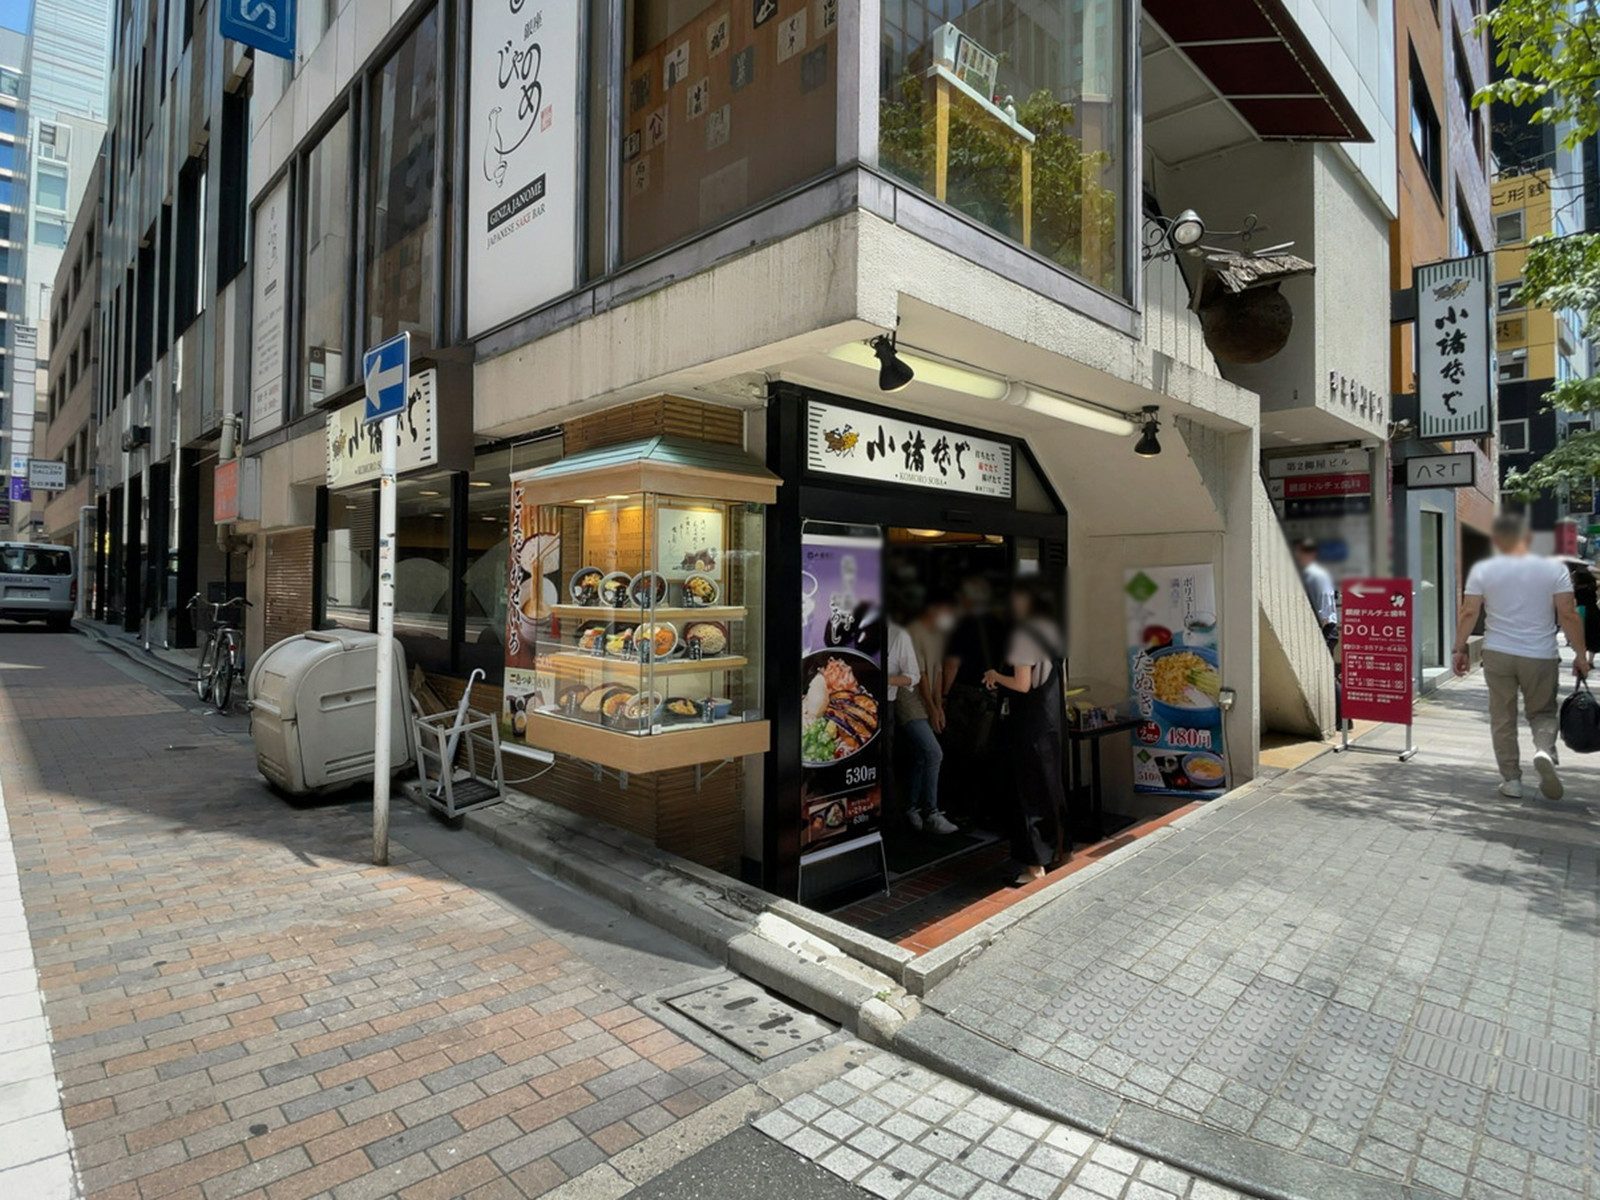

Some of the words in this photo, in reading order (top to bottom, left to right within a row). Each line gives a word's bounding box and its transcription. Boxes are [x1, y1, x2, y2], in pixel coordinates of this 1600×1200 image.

[489, 203, 512, 225] GINZA
[510, 180, 543, 214] JANOME
[487, 222, 515, 250] JAPANESE
[515, 212, 531, 230] SAKE
[531, 203, 546, 219] BAR
[1344, 624, 1406, 637] DOLCE
[1134, 649, 1155, 716] たぬき
[1167, 727, 1212, 748] 480円
[846, 765, 876, 785] 530円
